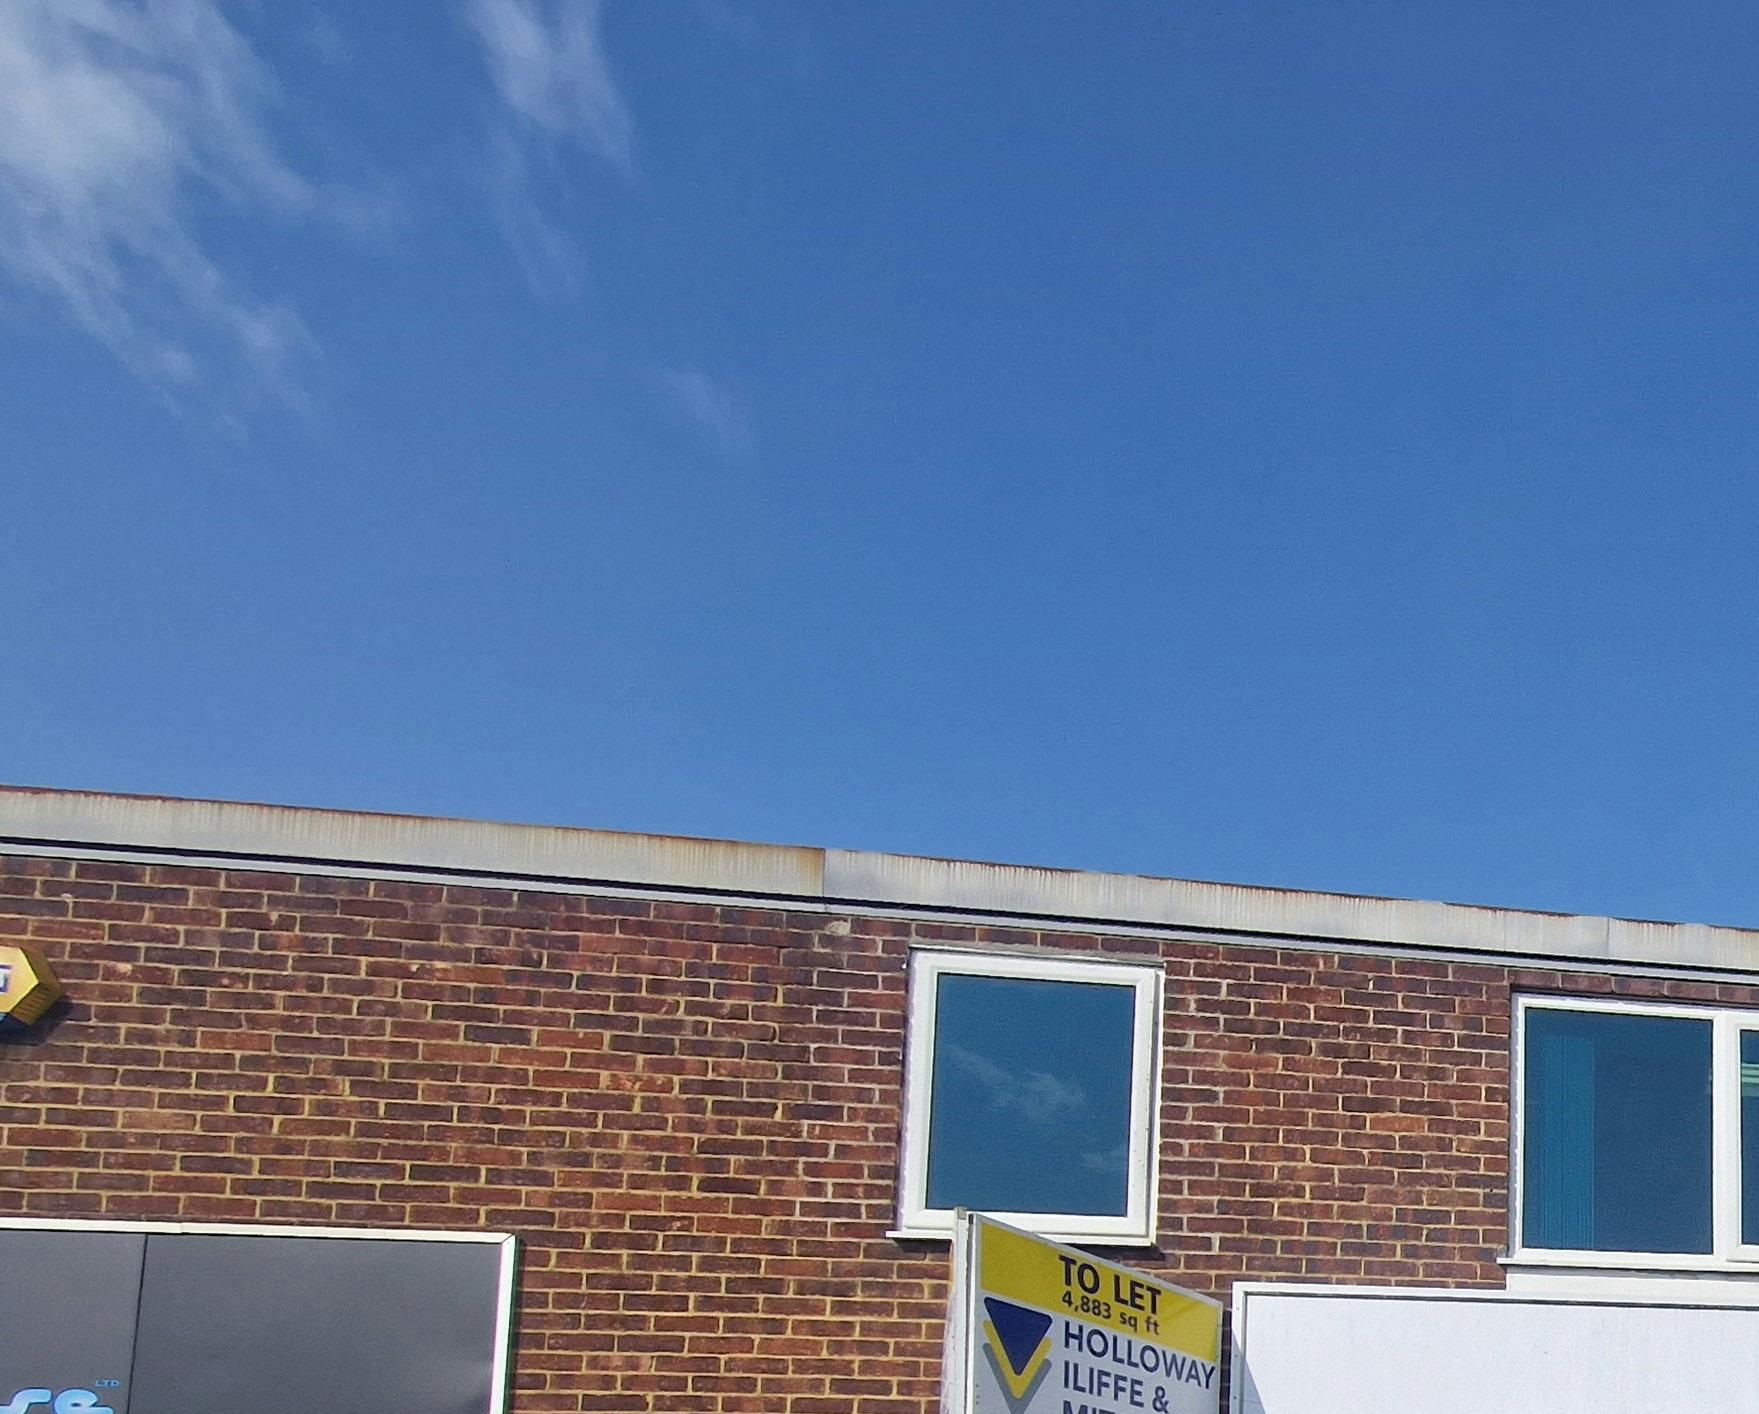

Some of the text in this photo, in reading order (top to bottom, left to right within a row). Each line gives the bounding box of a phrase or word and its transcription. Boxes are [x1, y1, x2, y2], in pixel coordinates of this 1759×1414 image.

[1059, 1254, 1162, 1315] TO LET
[1062, 1290, 1160, 1336] 4,883 sq ft
[1064, 1320, 1216, 1390] HOLLOWAY
[1063, 1359, 1170, 1414] ILIFFE &
